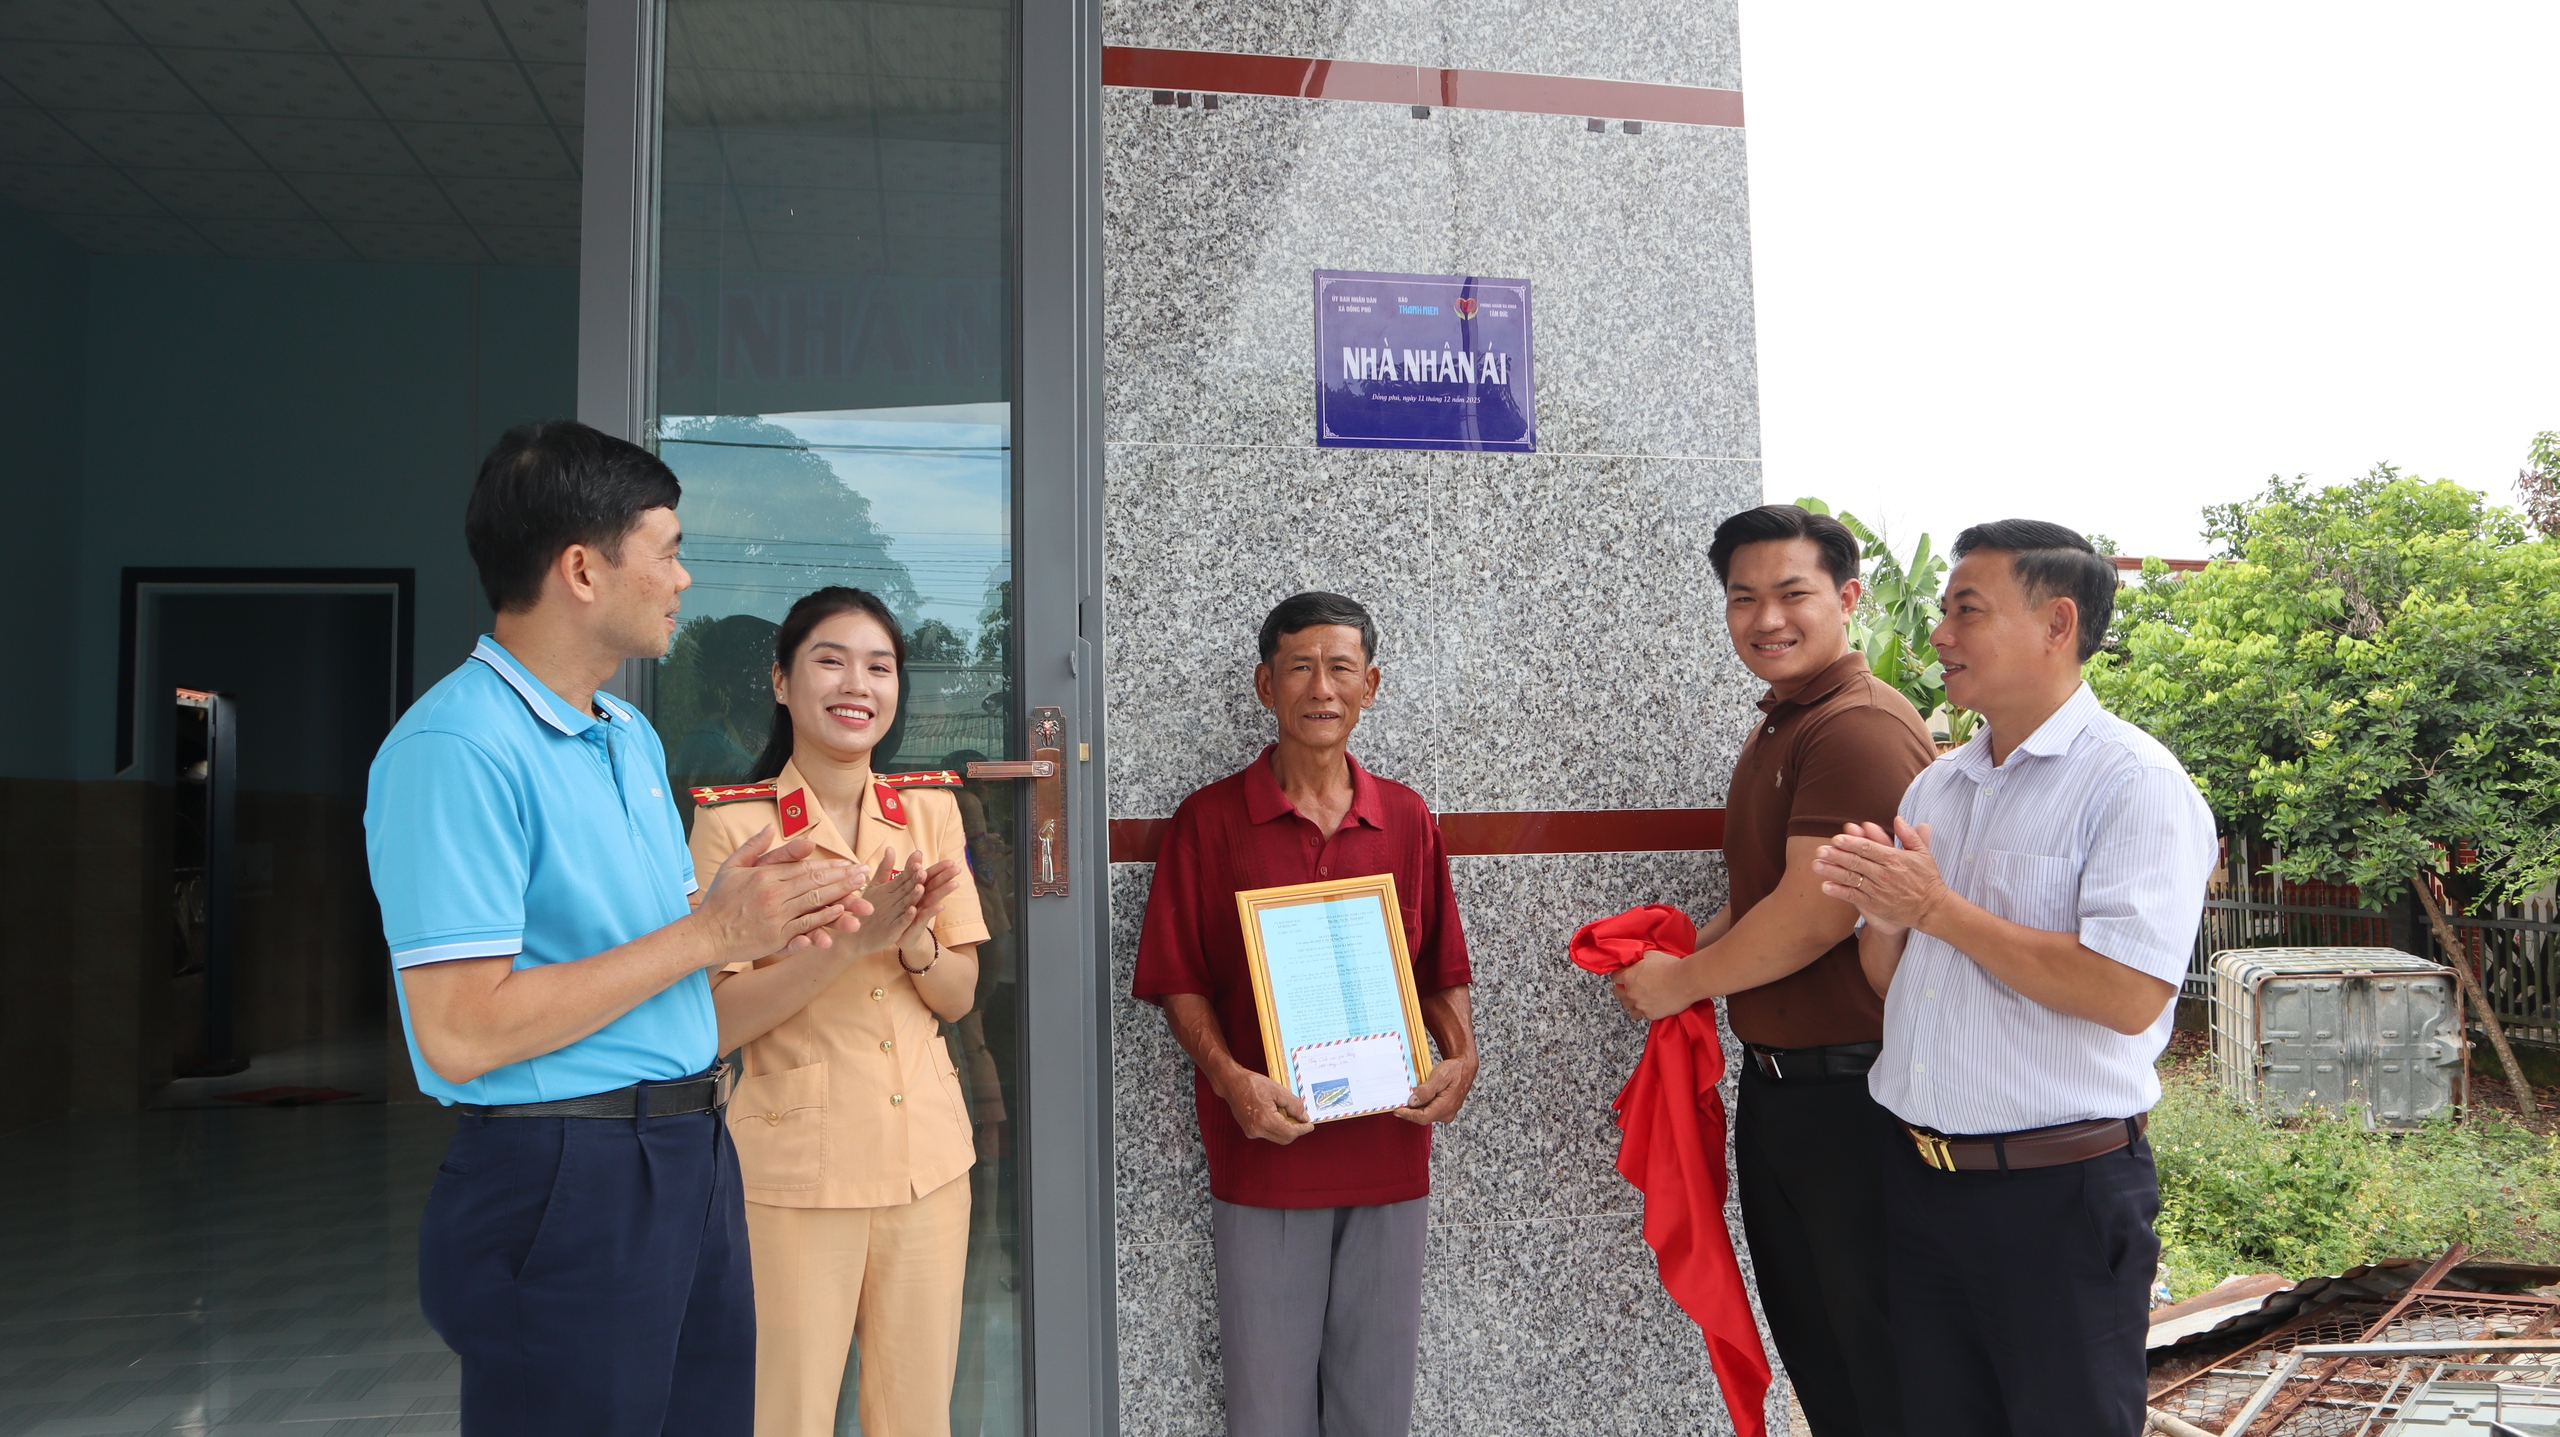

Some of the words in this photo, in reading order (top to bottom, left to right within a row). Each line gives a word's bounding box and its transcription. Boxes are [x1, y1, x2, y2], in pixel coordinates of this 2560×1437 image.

[1339, 295, 1350, 303] BAN
[1343, 337, 1399, 381] NHÀ
[1403, 341, 1475, 384] NHÂN
[1480, 341, 1508, 385] ÁI
[1402, 394, 1417, 402] ngày
[1443, 395, 1451, 403] 12
[1466, 396, 1481, 404] 2025
